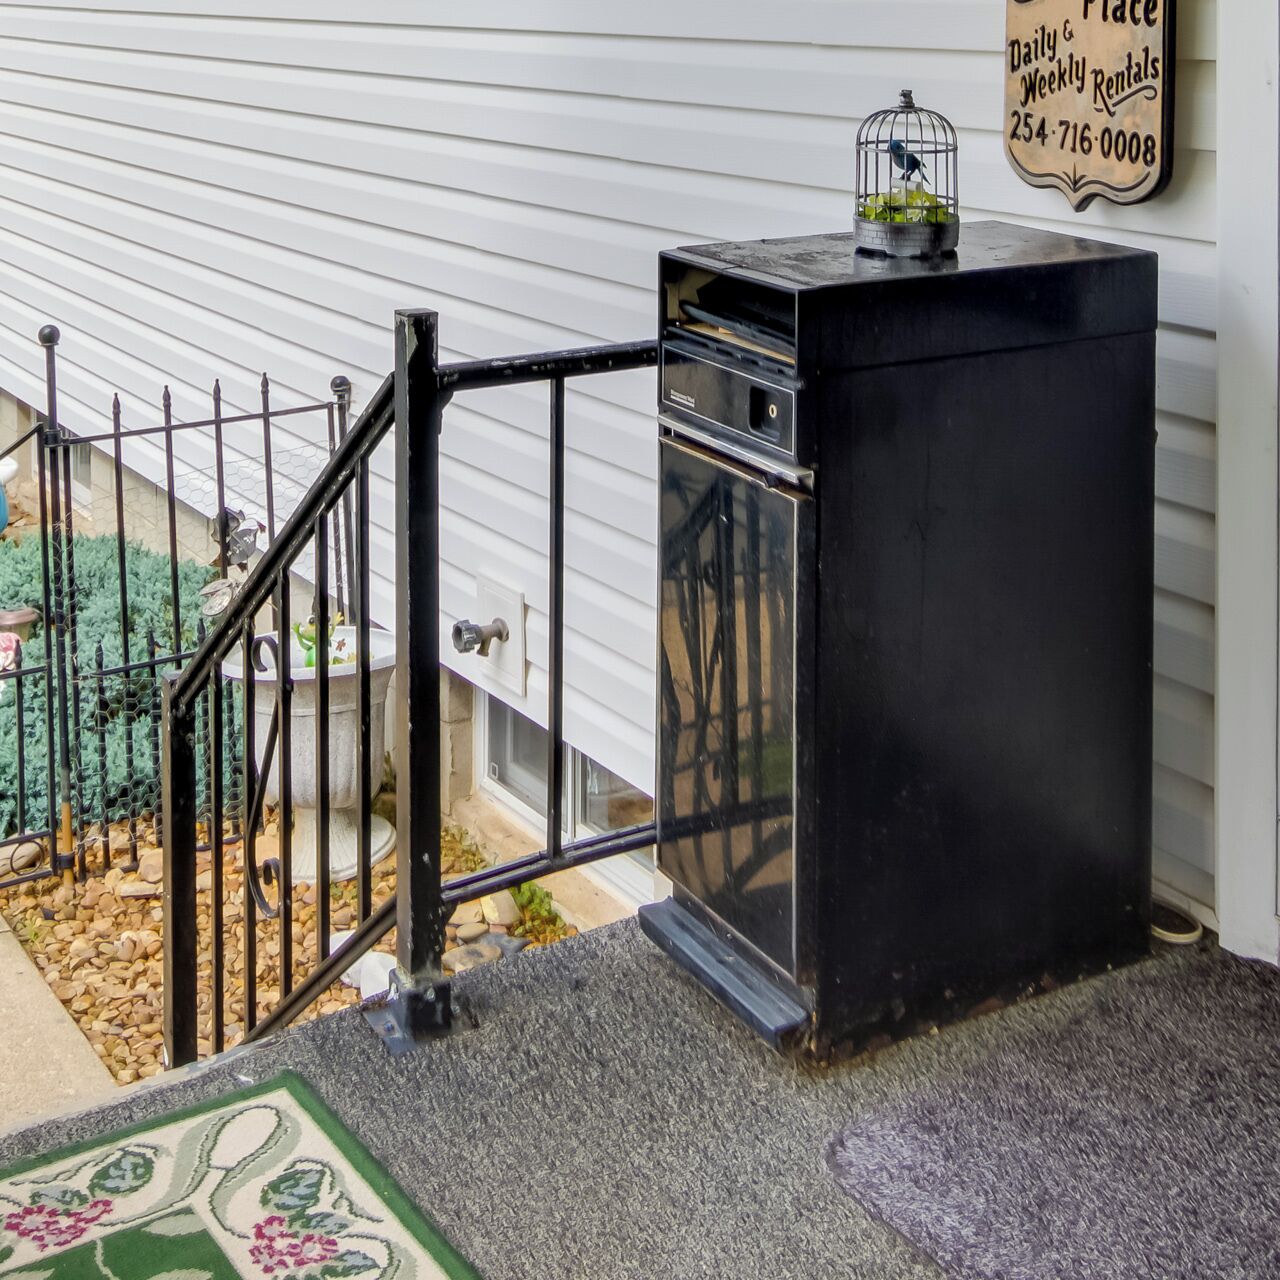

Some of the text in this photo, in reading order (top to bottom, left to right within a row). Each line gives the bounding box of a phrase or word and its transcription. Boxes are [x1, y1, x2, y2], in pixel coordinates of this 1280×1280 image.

[1008, 18, 1074, 73] Daily &
[1020, 45, 1160, 117] Weekly Rentals
